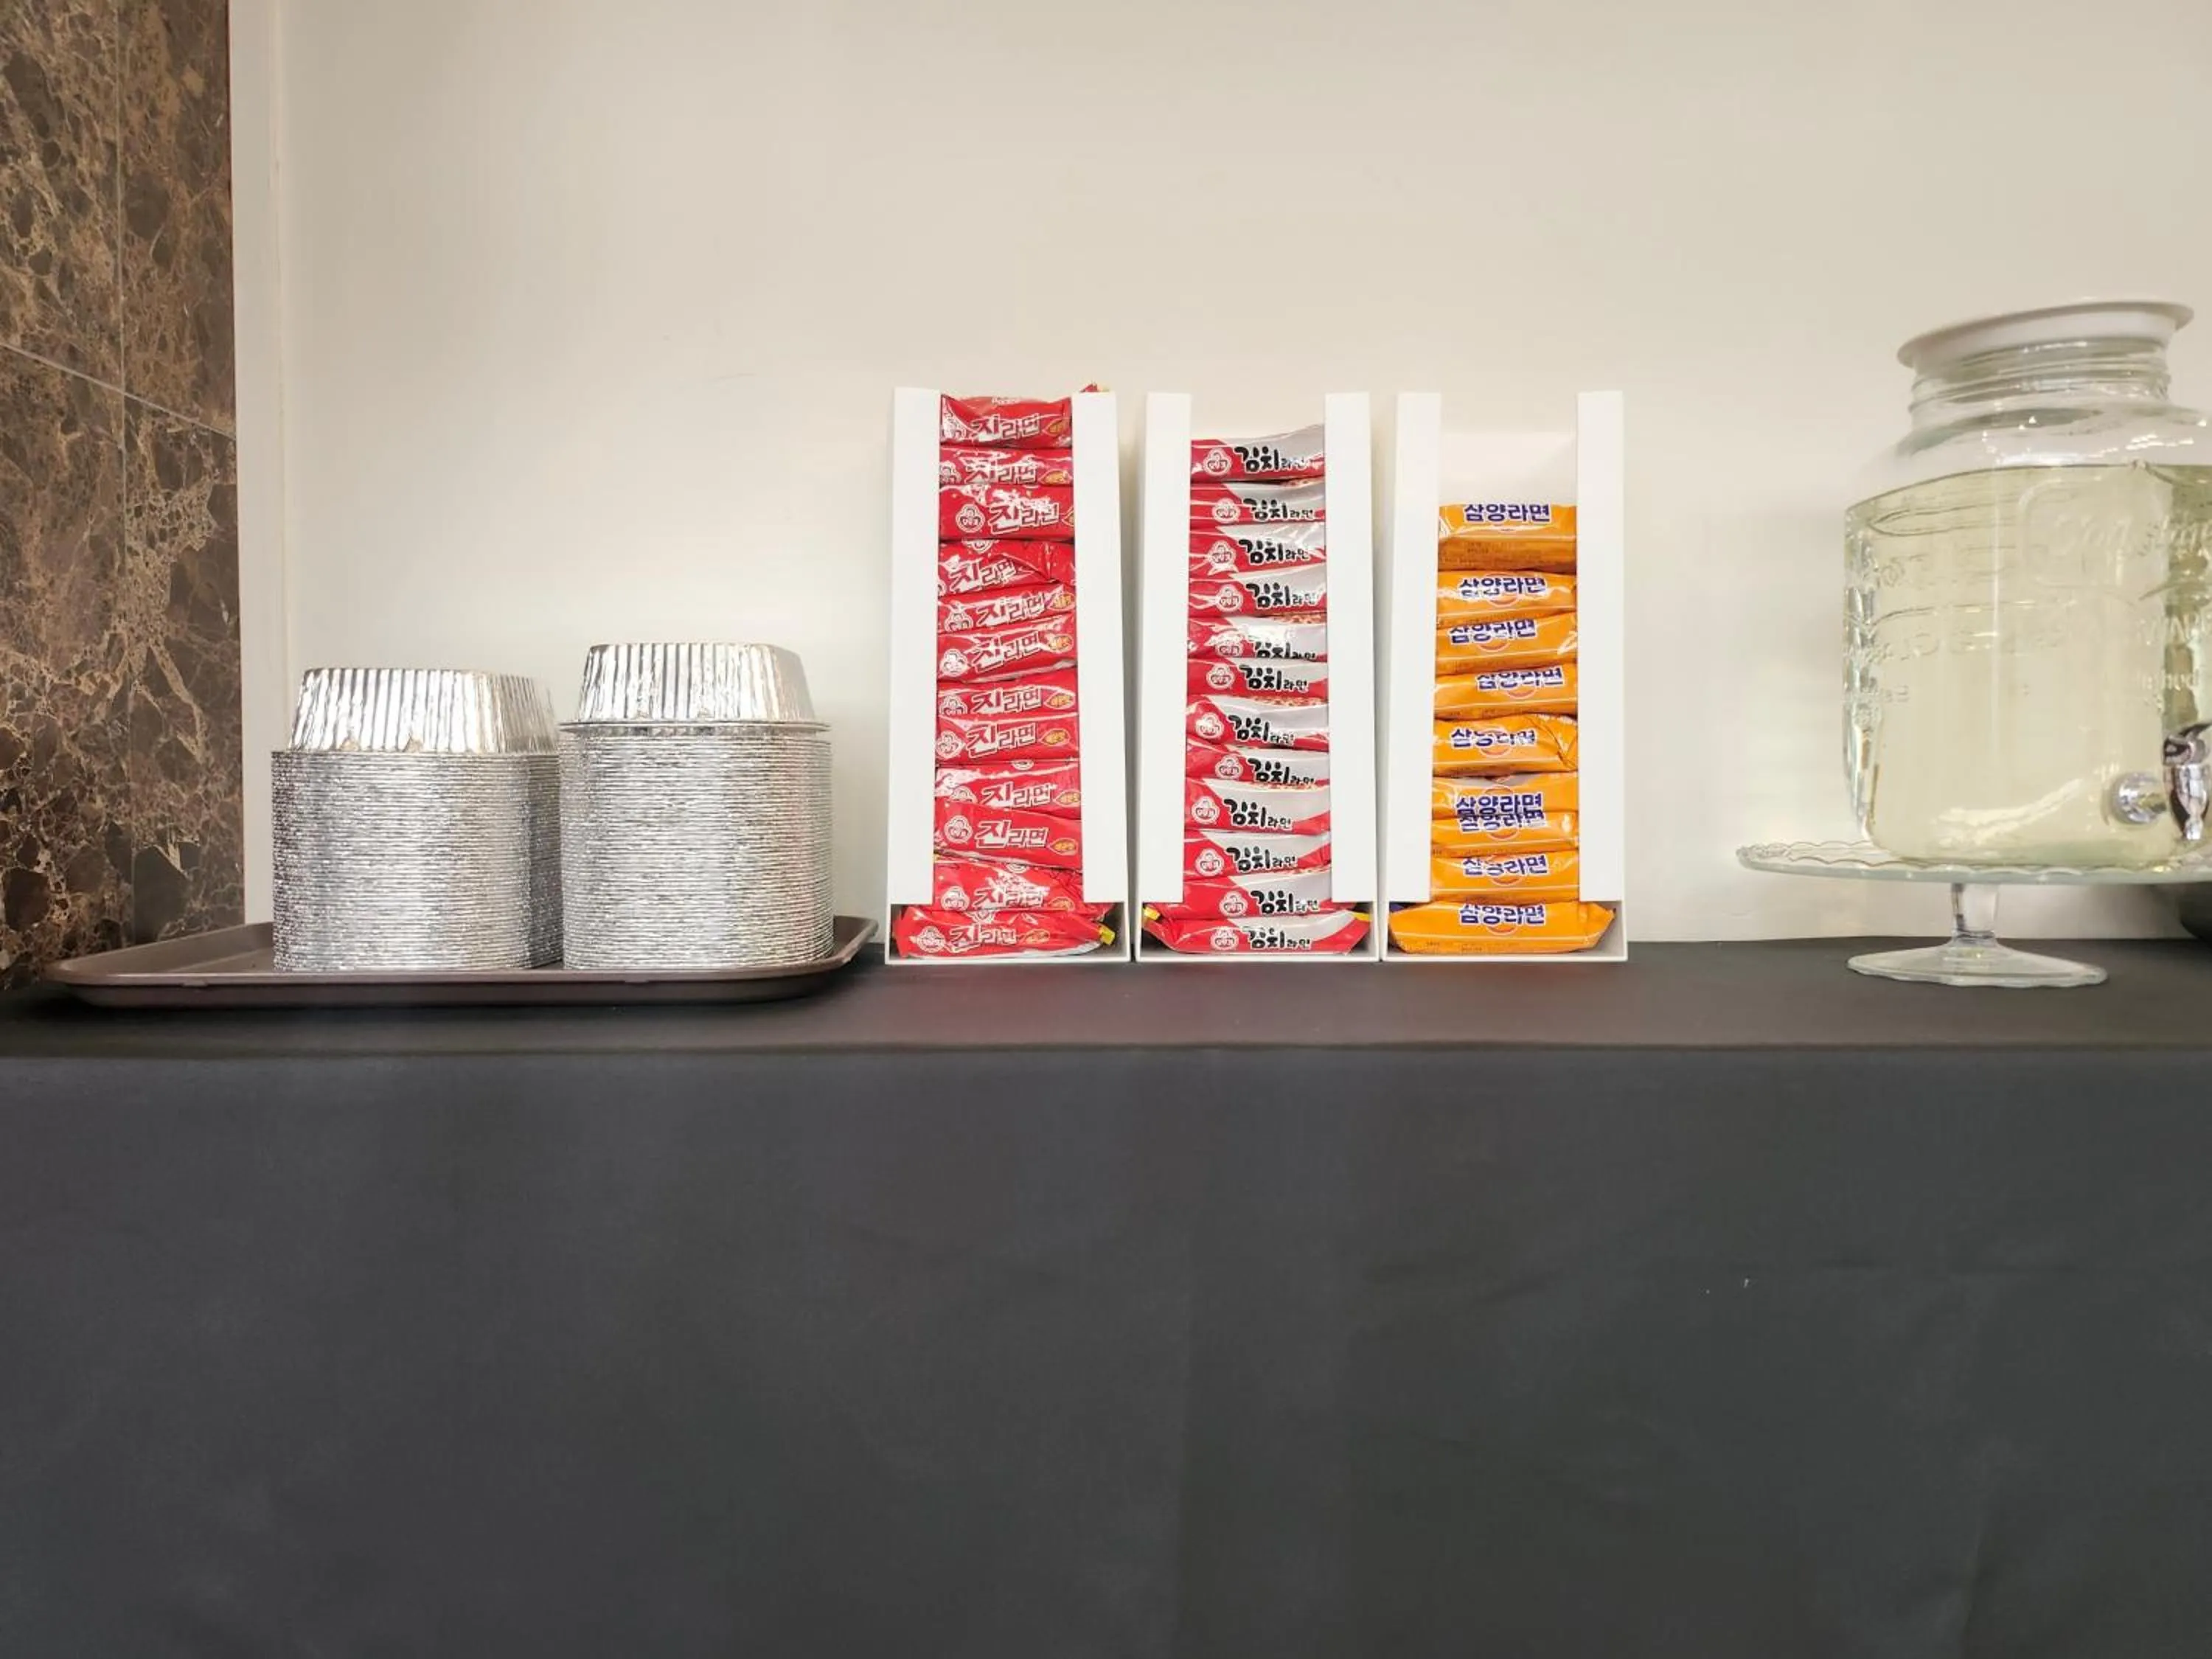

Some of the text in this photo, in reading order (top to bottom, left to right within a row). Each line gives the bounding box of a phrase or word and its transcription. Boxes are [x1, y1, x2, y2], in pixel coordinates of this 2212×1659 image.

[1464, 503, 1551, 523] 삼양라면
[971, 630, 1041, 673] 진라면
[966, 722, 1036, 758] 진라면
[975, 820, 1048, 849] 진라면
[1459, 904, 1545, 925] 삼양라면
